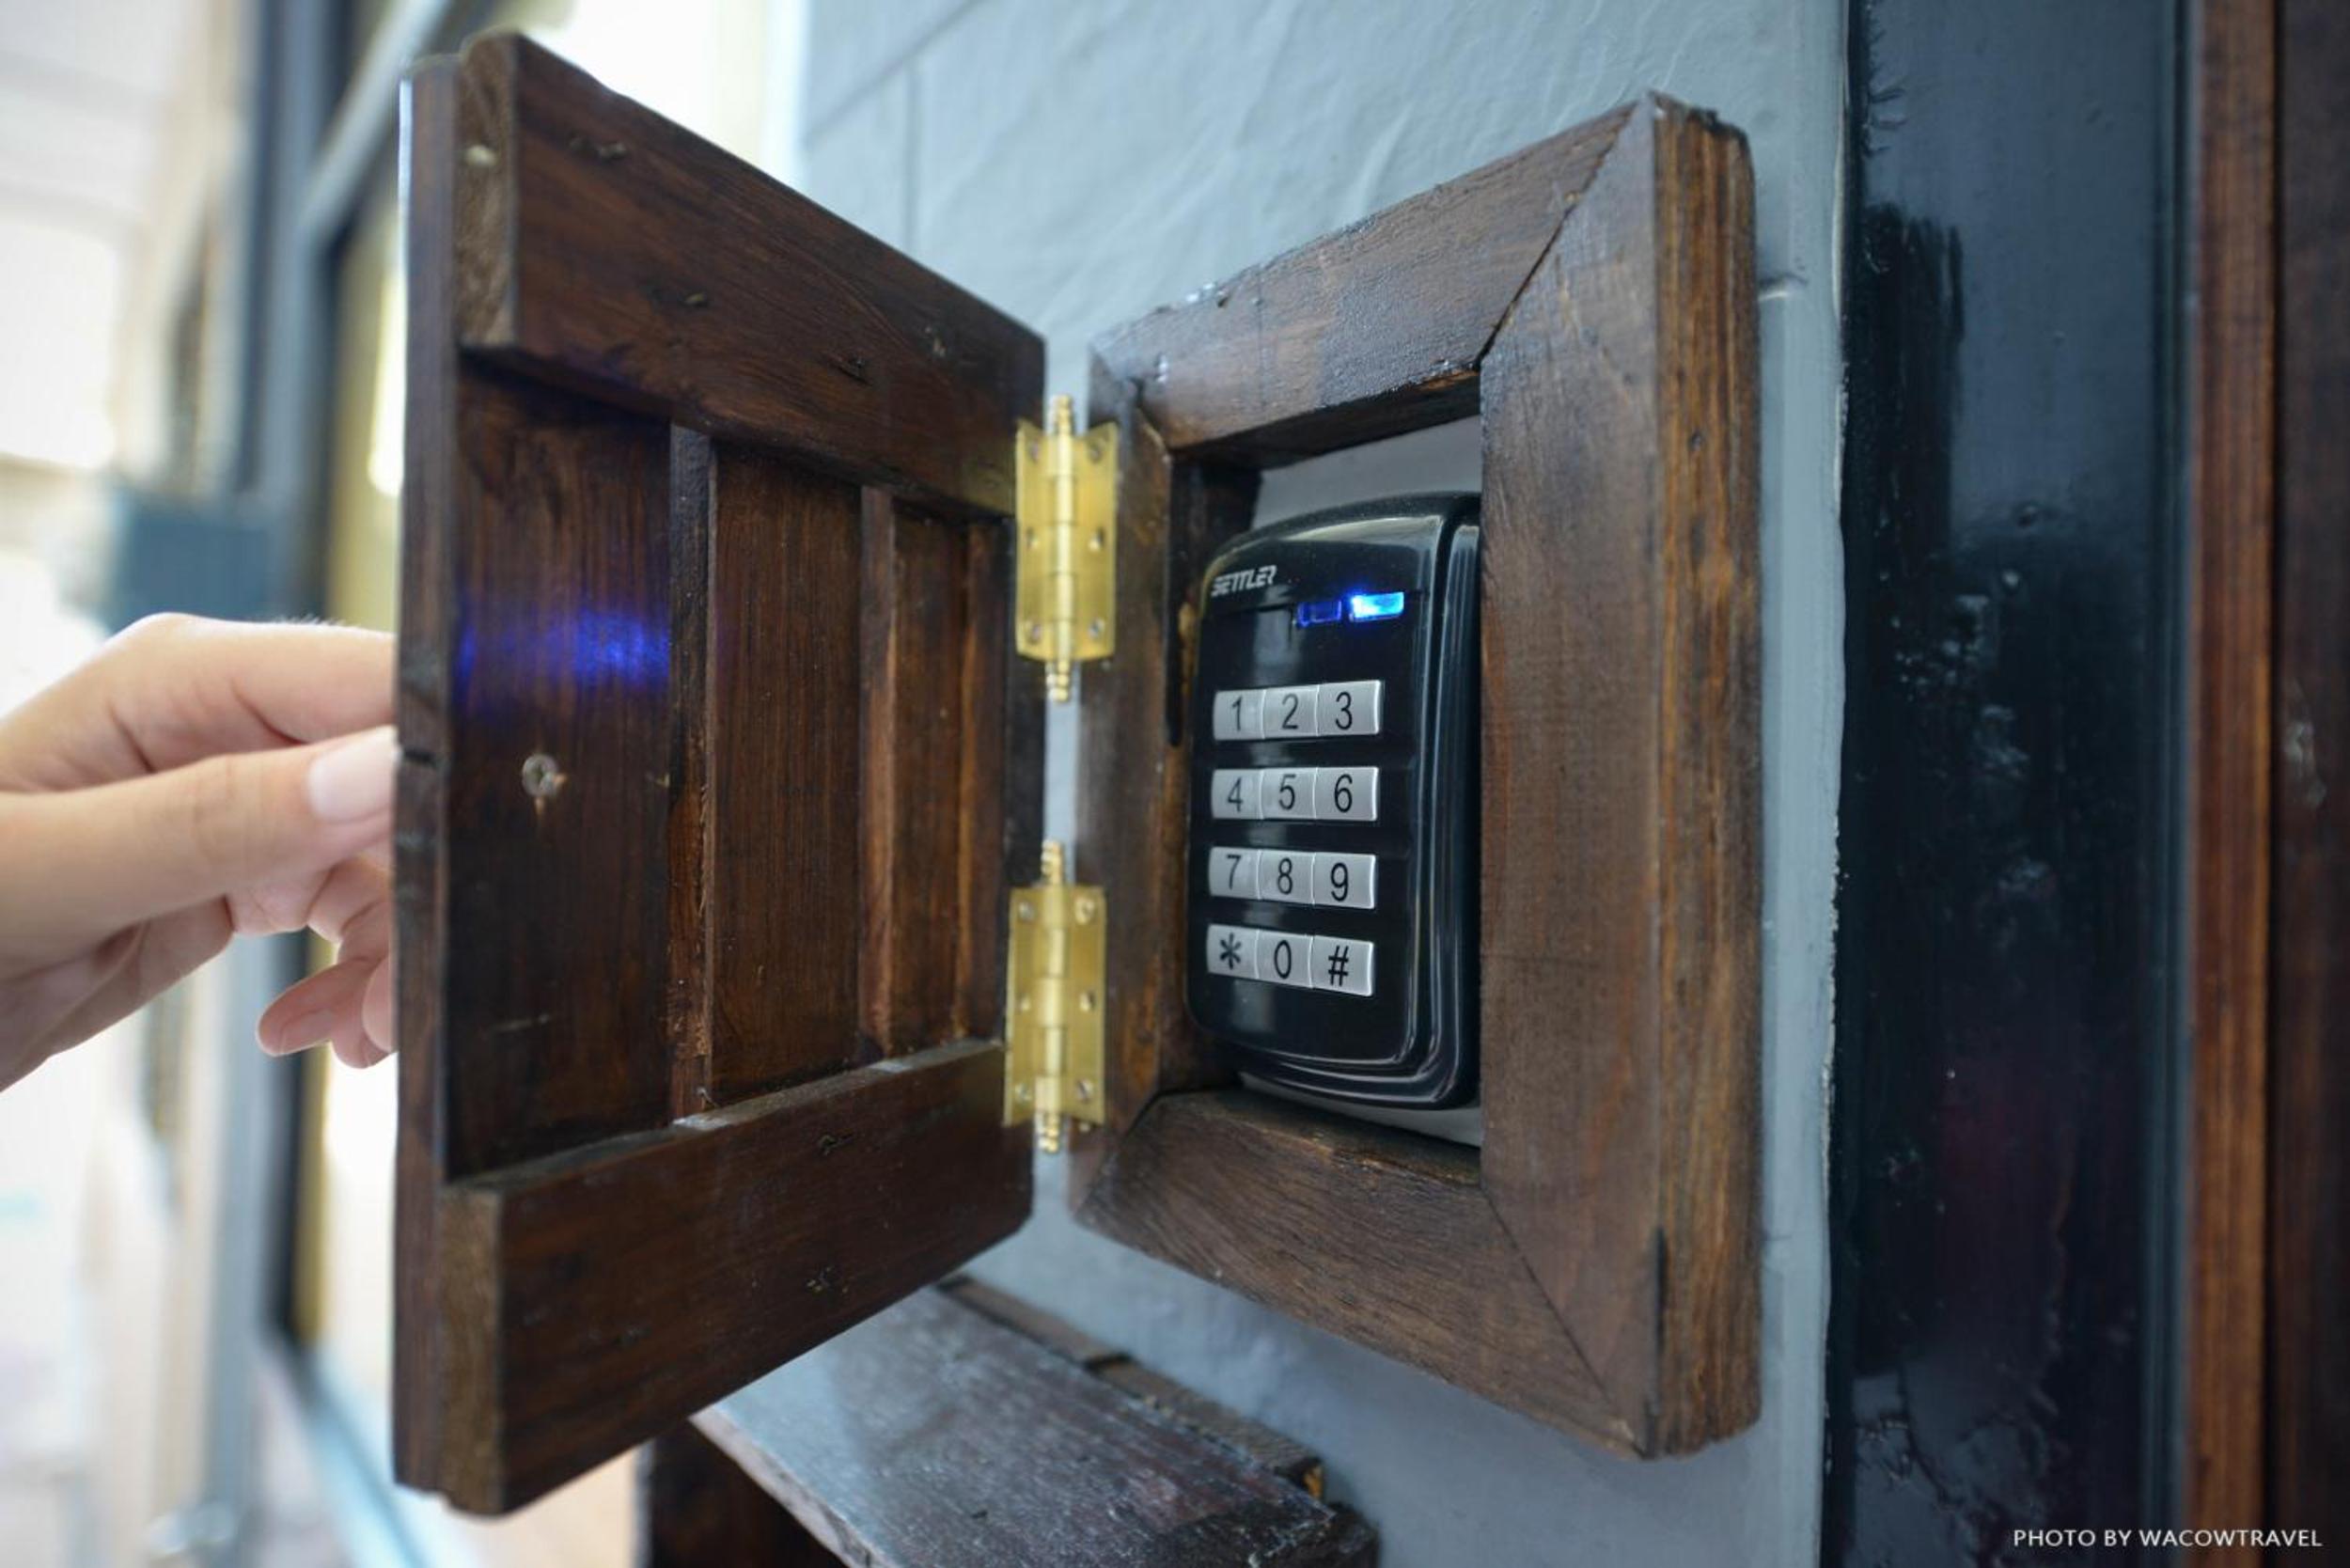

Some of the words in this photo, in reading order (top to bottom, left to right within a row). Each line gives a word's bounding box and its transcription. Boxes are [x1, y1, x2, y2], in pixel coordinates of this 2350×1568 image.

[1210, 565, 1277, 598] SETTLER
[1231, 695, 1243, 732] 1
[1281, 693, 1299, 729] 2
[1335, 691, 1354, 730] 3
[1227, 777, 1244, 812] 4
[1278, 774, 1296, 810] 5
[1334, 774, 1354, 813] 6
[1227, 854, 1242, 889] 7
[1277, 857, 1293, 895] 8
[1330, 862, 1349, 902] 9
[1274, 940, 1292, 980] 0
[1327, 945, 1350, 987] #
